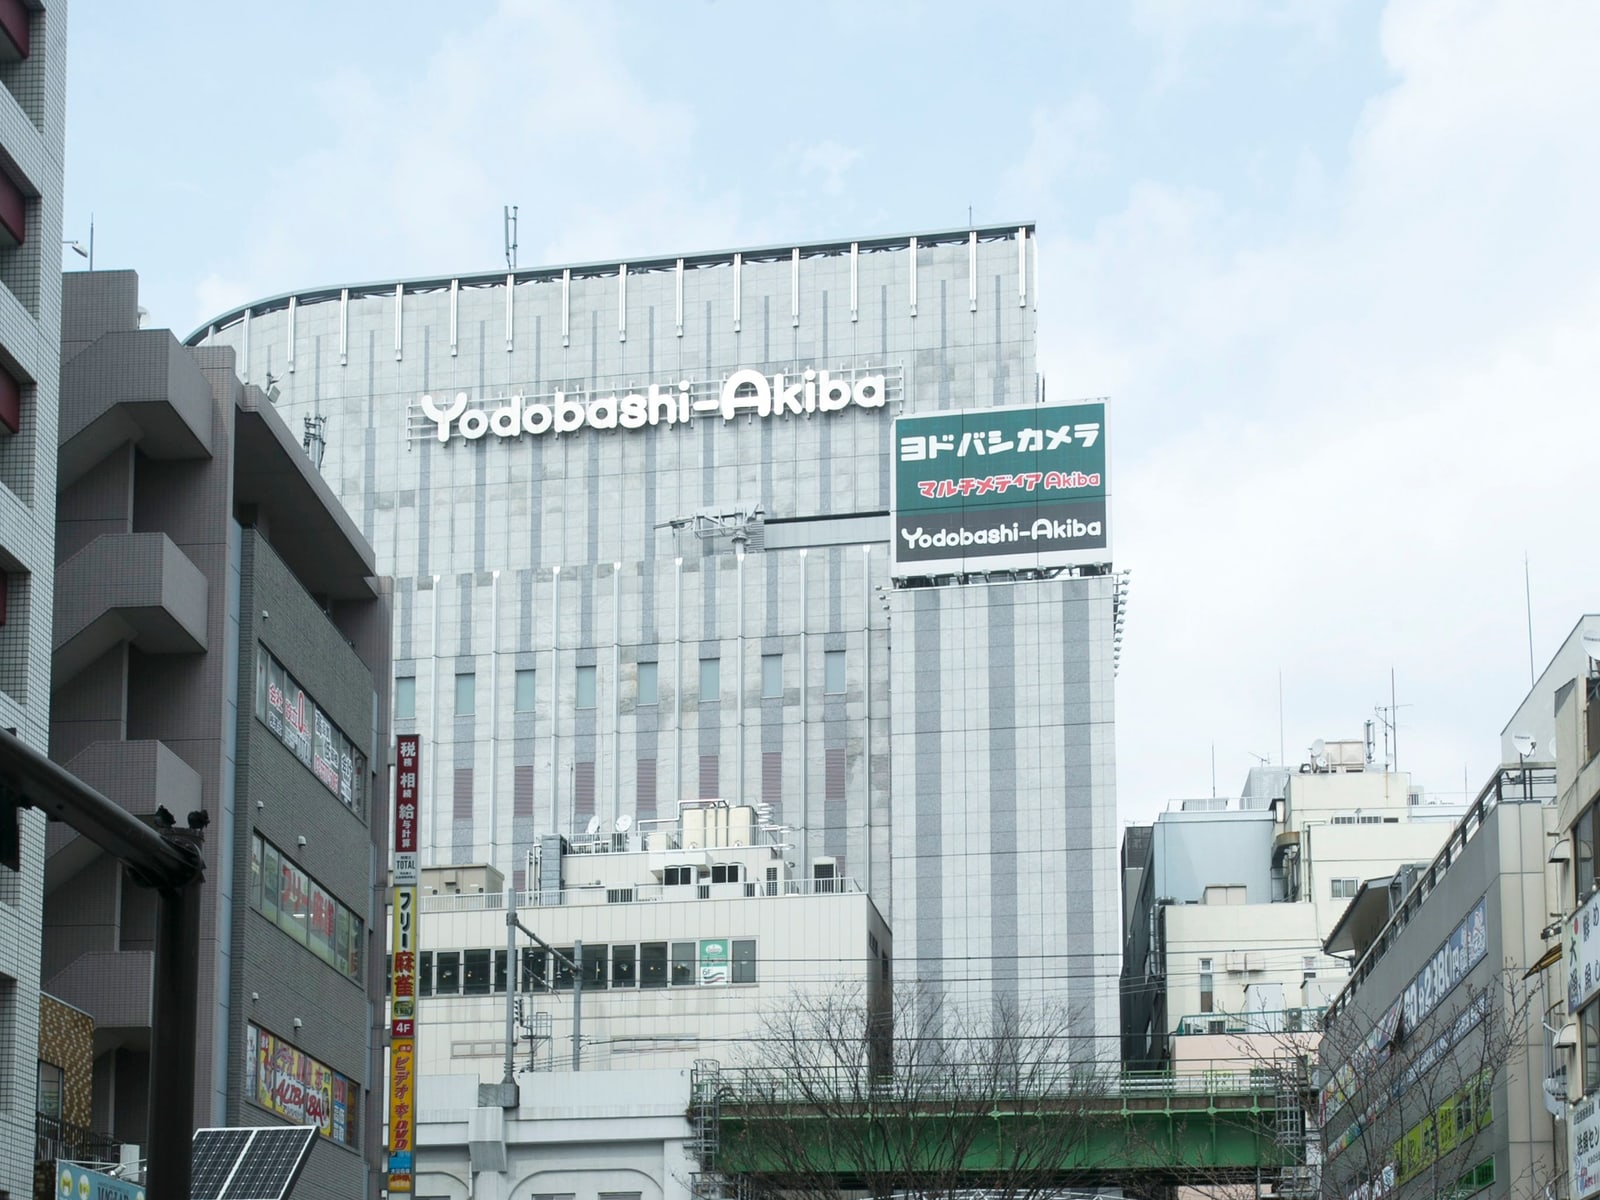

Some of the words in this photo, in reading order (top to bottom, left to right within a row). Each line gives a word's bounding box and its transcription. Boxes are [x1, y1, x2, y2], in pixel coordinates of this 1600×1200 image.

[421, 368, 886, 443] Yodobashi-Akiba
[900, 422, 1100, 462] ヨドバシカメラ
[917, 472, 1043, 498] マルチメディア
[1043, 471, 1101, 490] Akiba
[901, 518, 1101, 550] Yodobashi-Akiba
[396, 860, 416, 870] TOTAL
[396, 1022, 411, 1033] 4F
